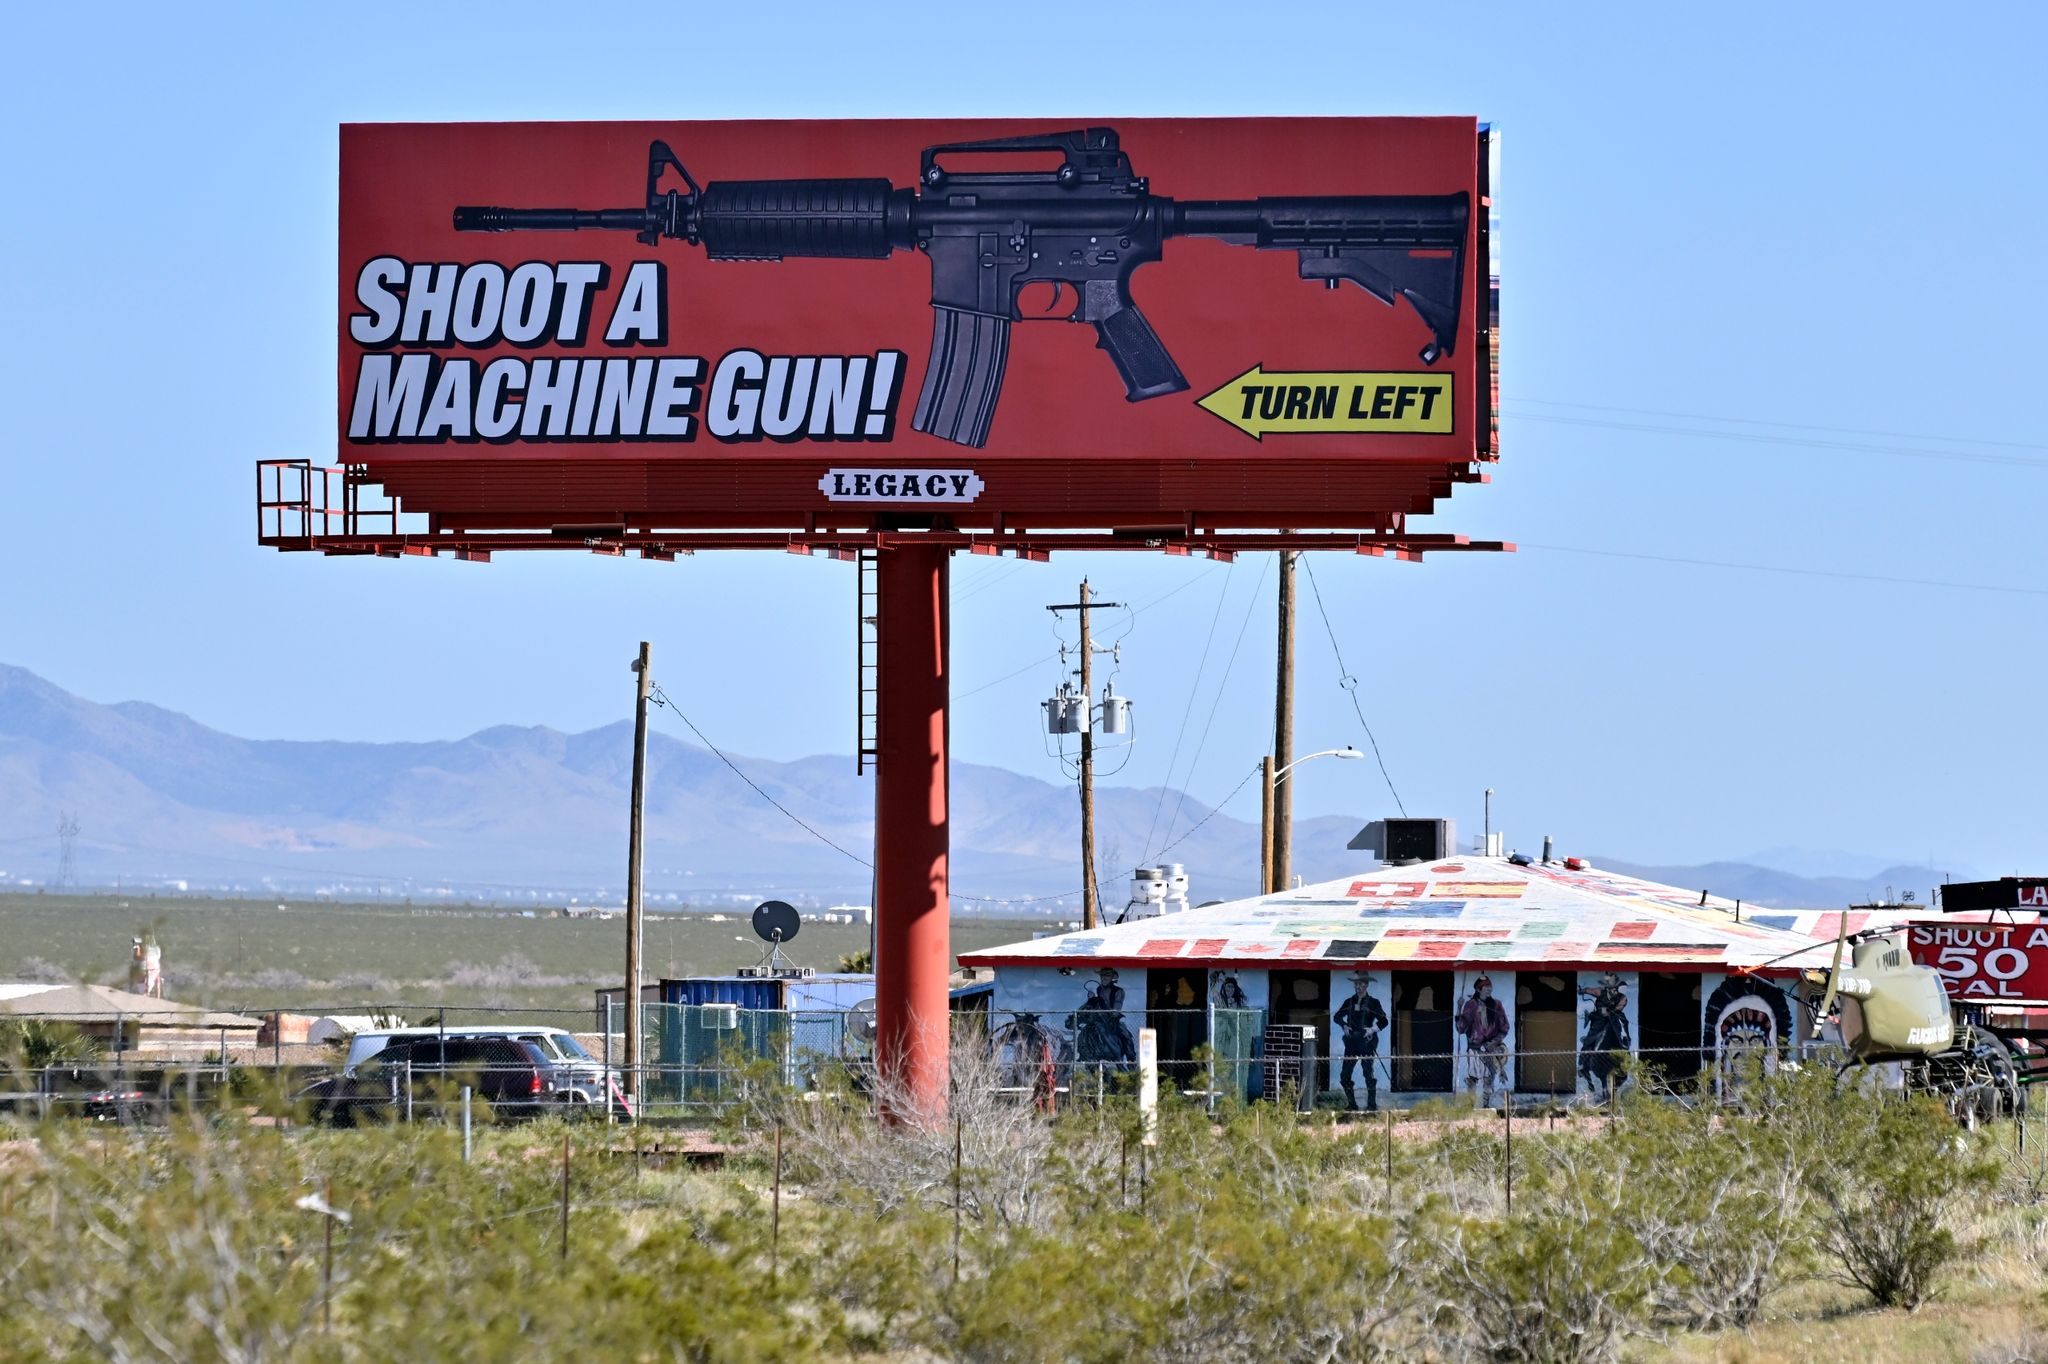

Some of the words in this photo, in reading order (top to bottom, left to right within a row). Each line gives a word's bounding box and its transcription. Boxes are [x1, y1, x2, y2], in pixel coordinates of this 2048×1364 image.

[349, 257, 605, 345] SHOOT
[604, 262, 665, 345] A
[346, 353, 704, 440] MACHINE
[707, 349, 903, 440] GUN!
[1240, 385, 1339, 420] TURN
[1348, 385, 1442, 421] LEFT
[833, 473, 970, 497] LEGACY
[1913, 926, 2014, 948] SHOOT
[2025, 927, 2048, 949] A
[1936, 946, 2029, 980] 50
[1942, 978, 2023, 997] CAL
